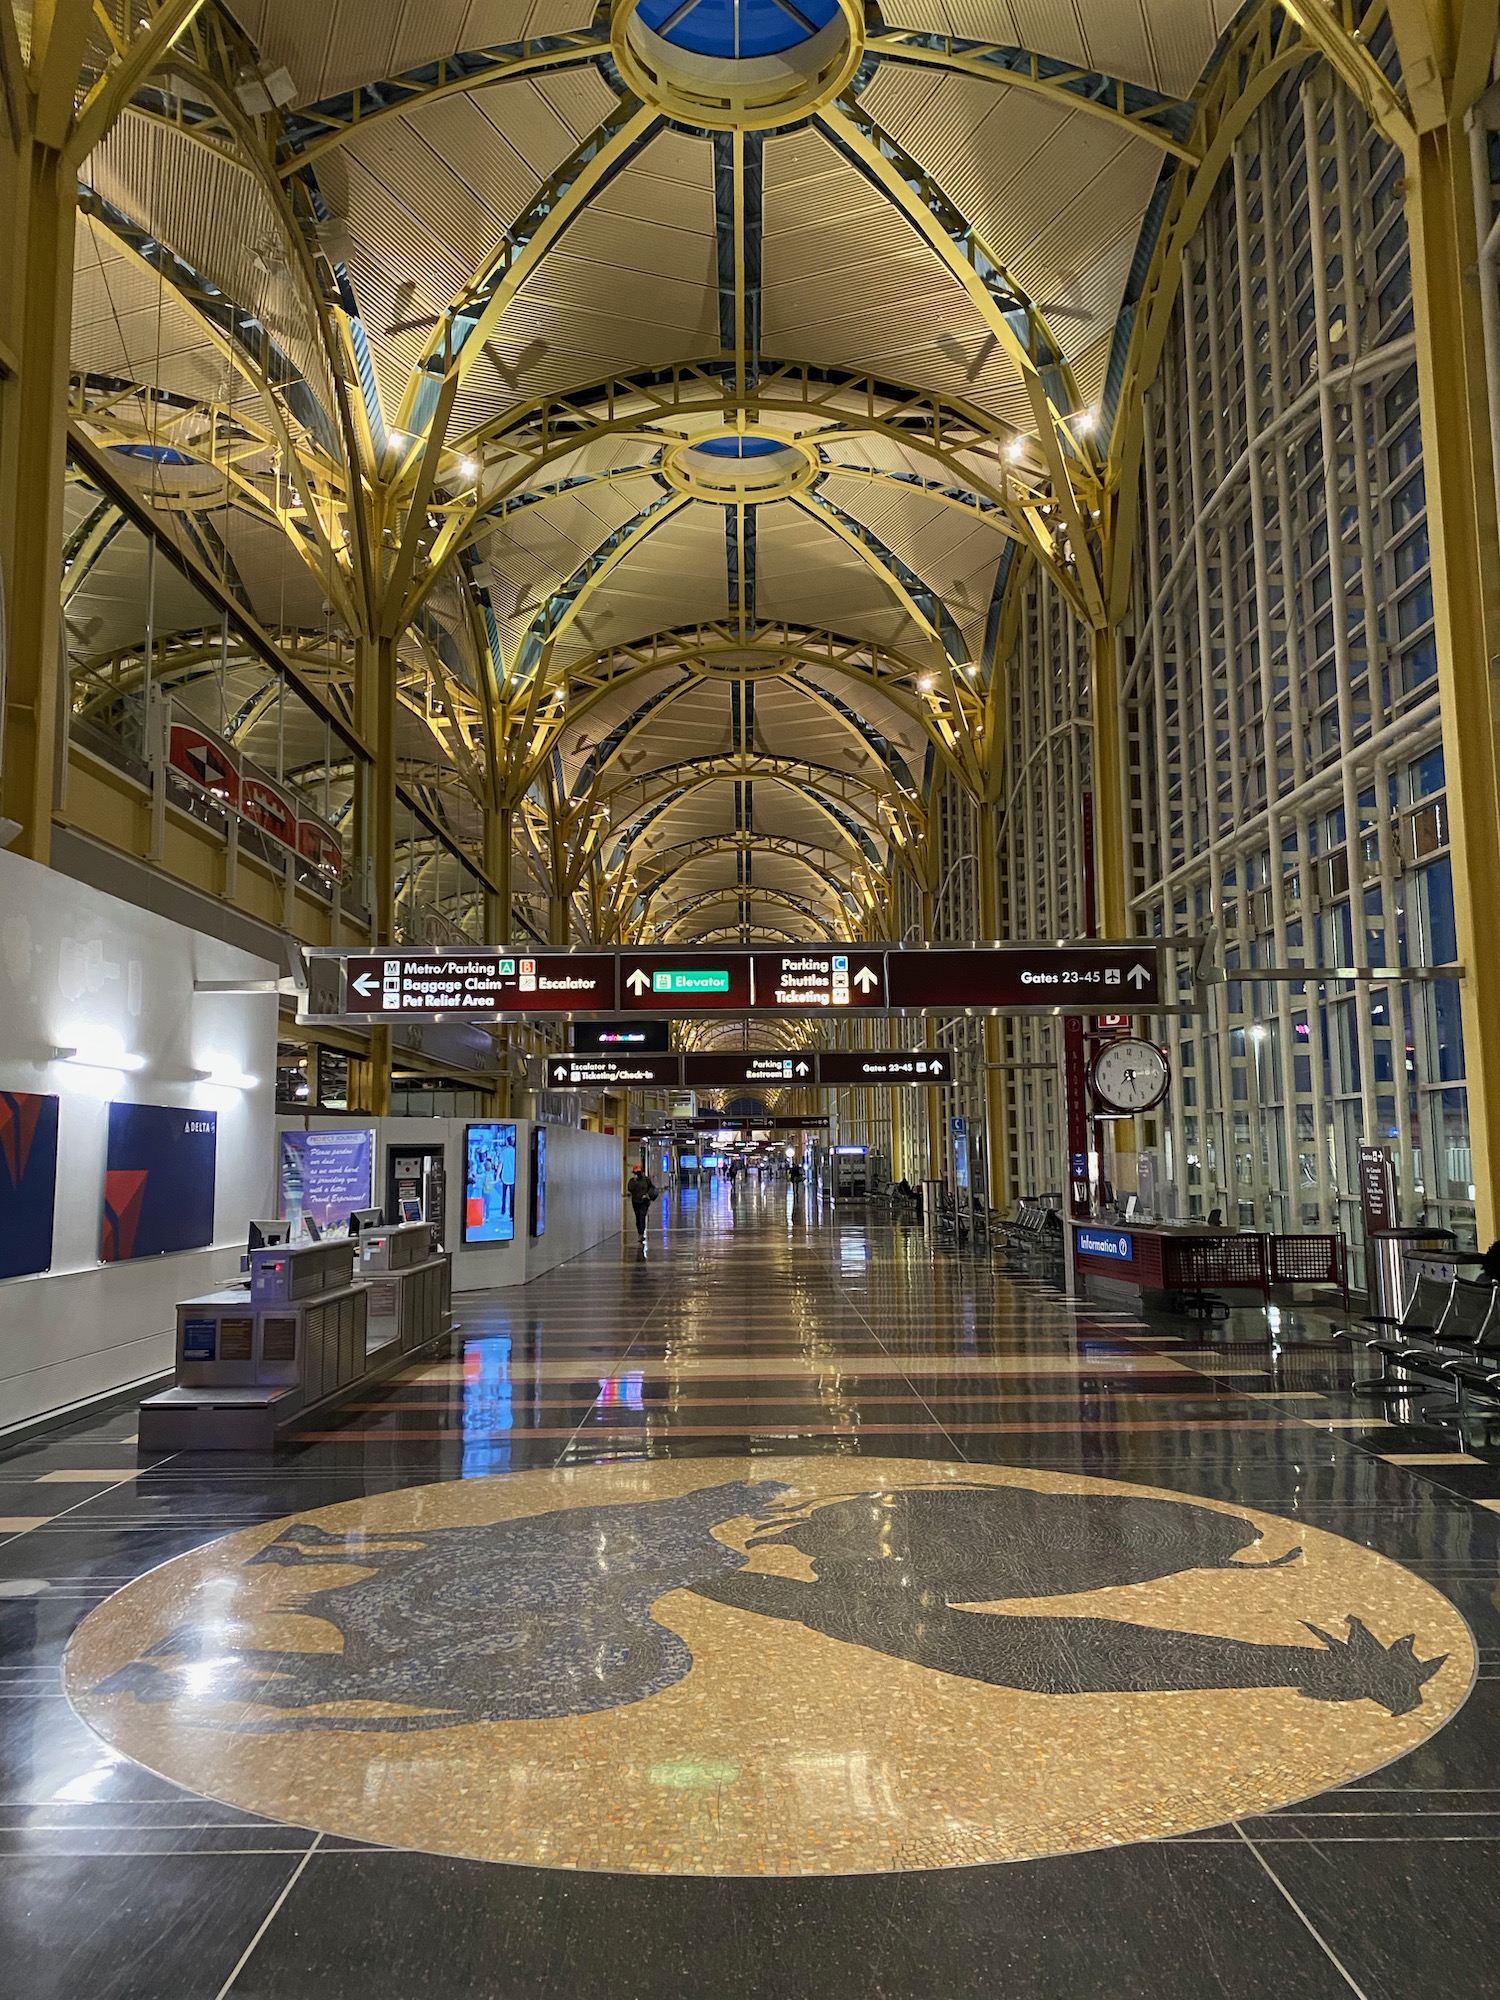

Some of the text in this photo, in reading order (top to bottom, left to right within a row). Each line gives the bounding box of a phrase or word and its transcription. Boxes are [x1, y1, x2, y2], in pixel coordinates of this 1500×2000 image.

[403, 961, 496, 977] Metro/Parking
[502, 962, 513, 973] A
[523, 962, 532, 973] B
[781, 958, 845, 973] Parking C
[675, 975, 726, 988] Elevator
[780, 973, 830, 987] Shuttles
[1020, 971, 1101, 984] Gates 23-45
[402, 978, 462, 994] Baggage
[464, 977, 502, 991] Claim
[538, 976, 596, 990] Escalator
[402, 993, 495, 1008] Pet Relief Area
[774, 990, 830, 1006] Ticketing
[570, 1062, 617, 1071] Escalator to
[752, 1060, 782, 1070] Parking
[862, 1063, 913, 1073] Gates 23-45
[581, 1071, 654, 1081] Ticketing/Check-in
[746, 1069, 782, 1079] Restroom
[190, 1121, 210, 1133] DELTA
[310, 1147, 353, 1156] Please pardon
[328, 1166, 343, 1174] work
[343, 1165, 359, 1173] hard
[316, 1176, 345, 1185] providing
[346, 1177, 358, 1185] you
[309, 1185, 323, 1193] with
[330, 1184, 347, 1192] better
[309, 1192, 366, 1203] Travel Experience!
[1080, 1234, 1118, 1254] Information
